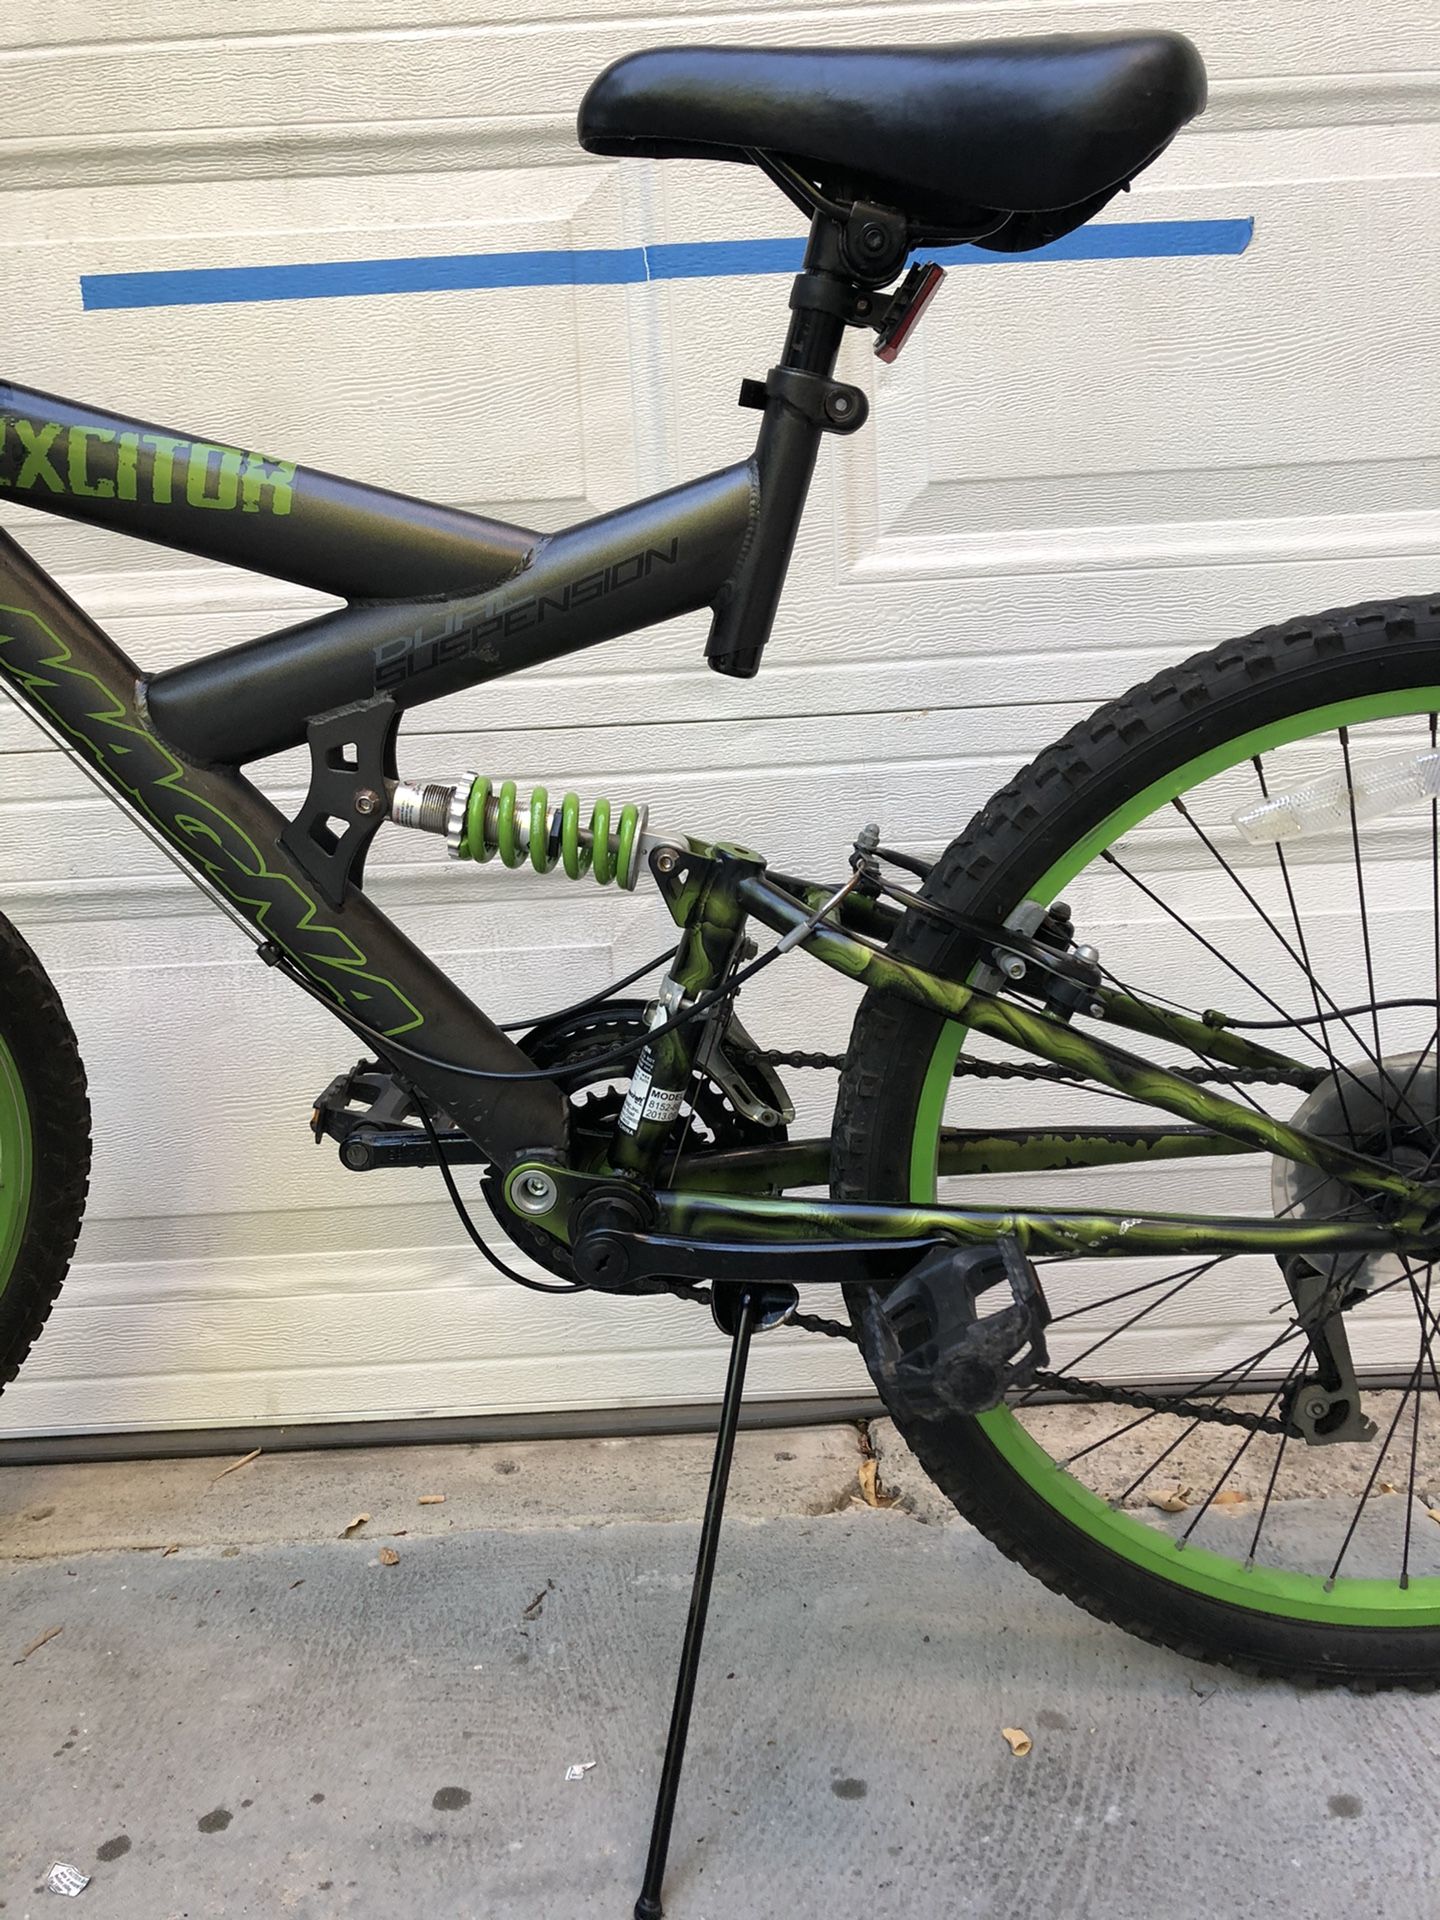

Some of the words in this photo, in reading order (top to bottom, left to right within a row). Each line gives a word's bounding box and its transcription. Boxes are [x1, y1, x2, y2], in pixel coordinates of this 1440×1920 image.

[0, 416, 297, 515] XCITOR
[374, 591, 538, 665] DUAL
[375, 536, 678, 690] SUSPENSION
